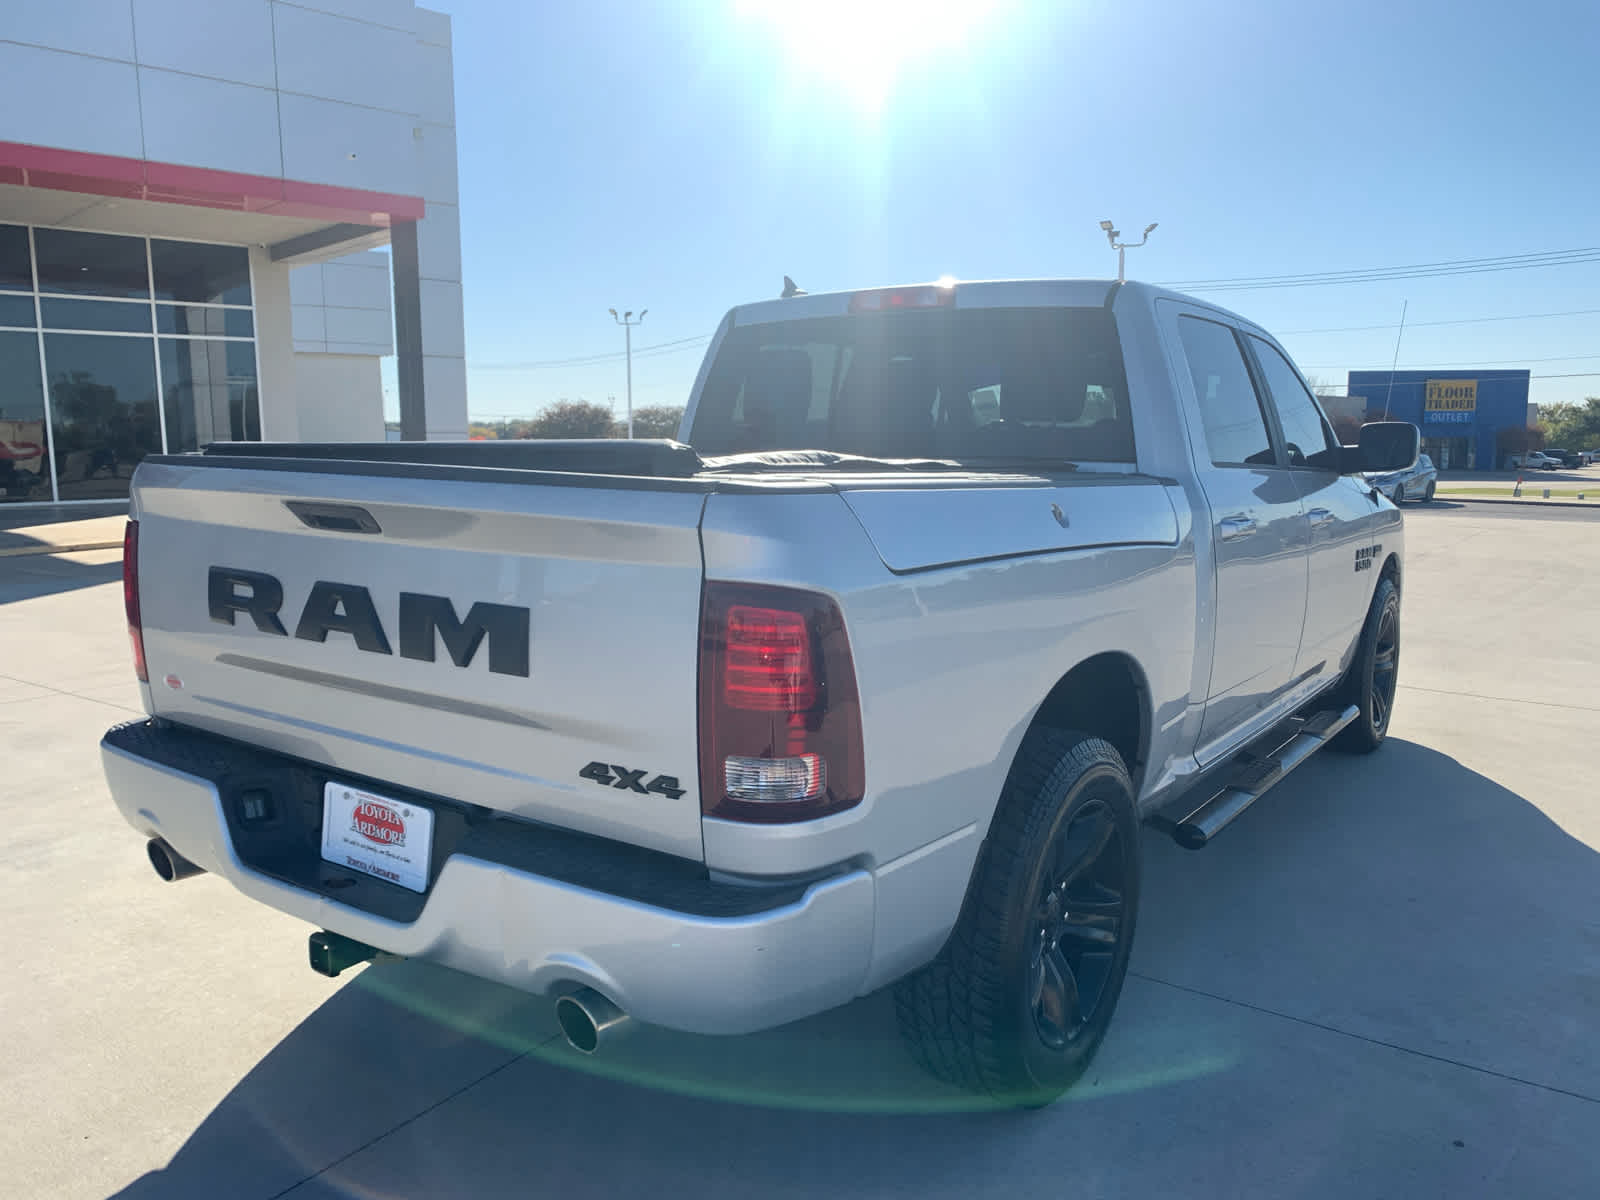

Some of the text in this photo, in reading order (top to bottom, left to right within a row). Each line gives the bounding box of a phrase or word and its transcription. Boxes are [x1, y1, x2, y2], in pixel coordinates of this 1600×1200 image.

[1429, 386, 1474, 399] FLOOR
[1428, 399, 1475, 409] TRADER
[1431, 412, 1469, 421] OUTLET
[208, 566, 530, 678] RAM
[359, 799, 402, 825] TOYOTA
[351, 816, 407, 848] ARDMORE
